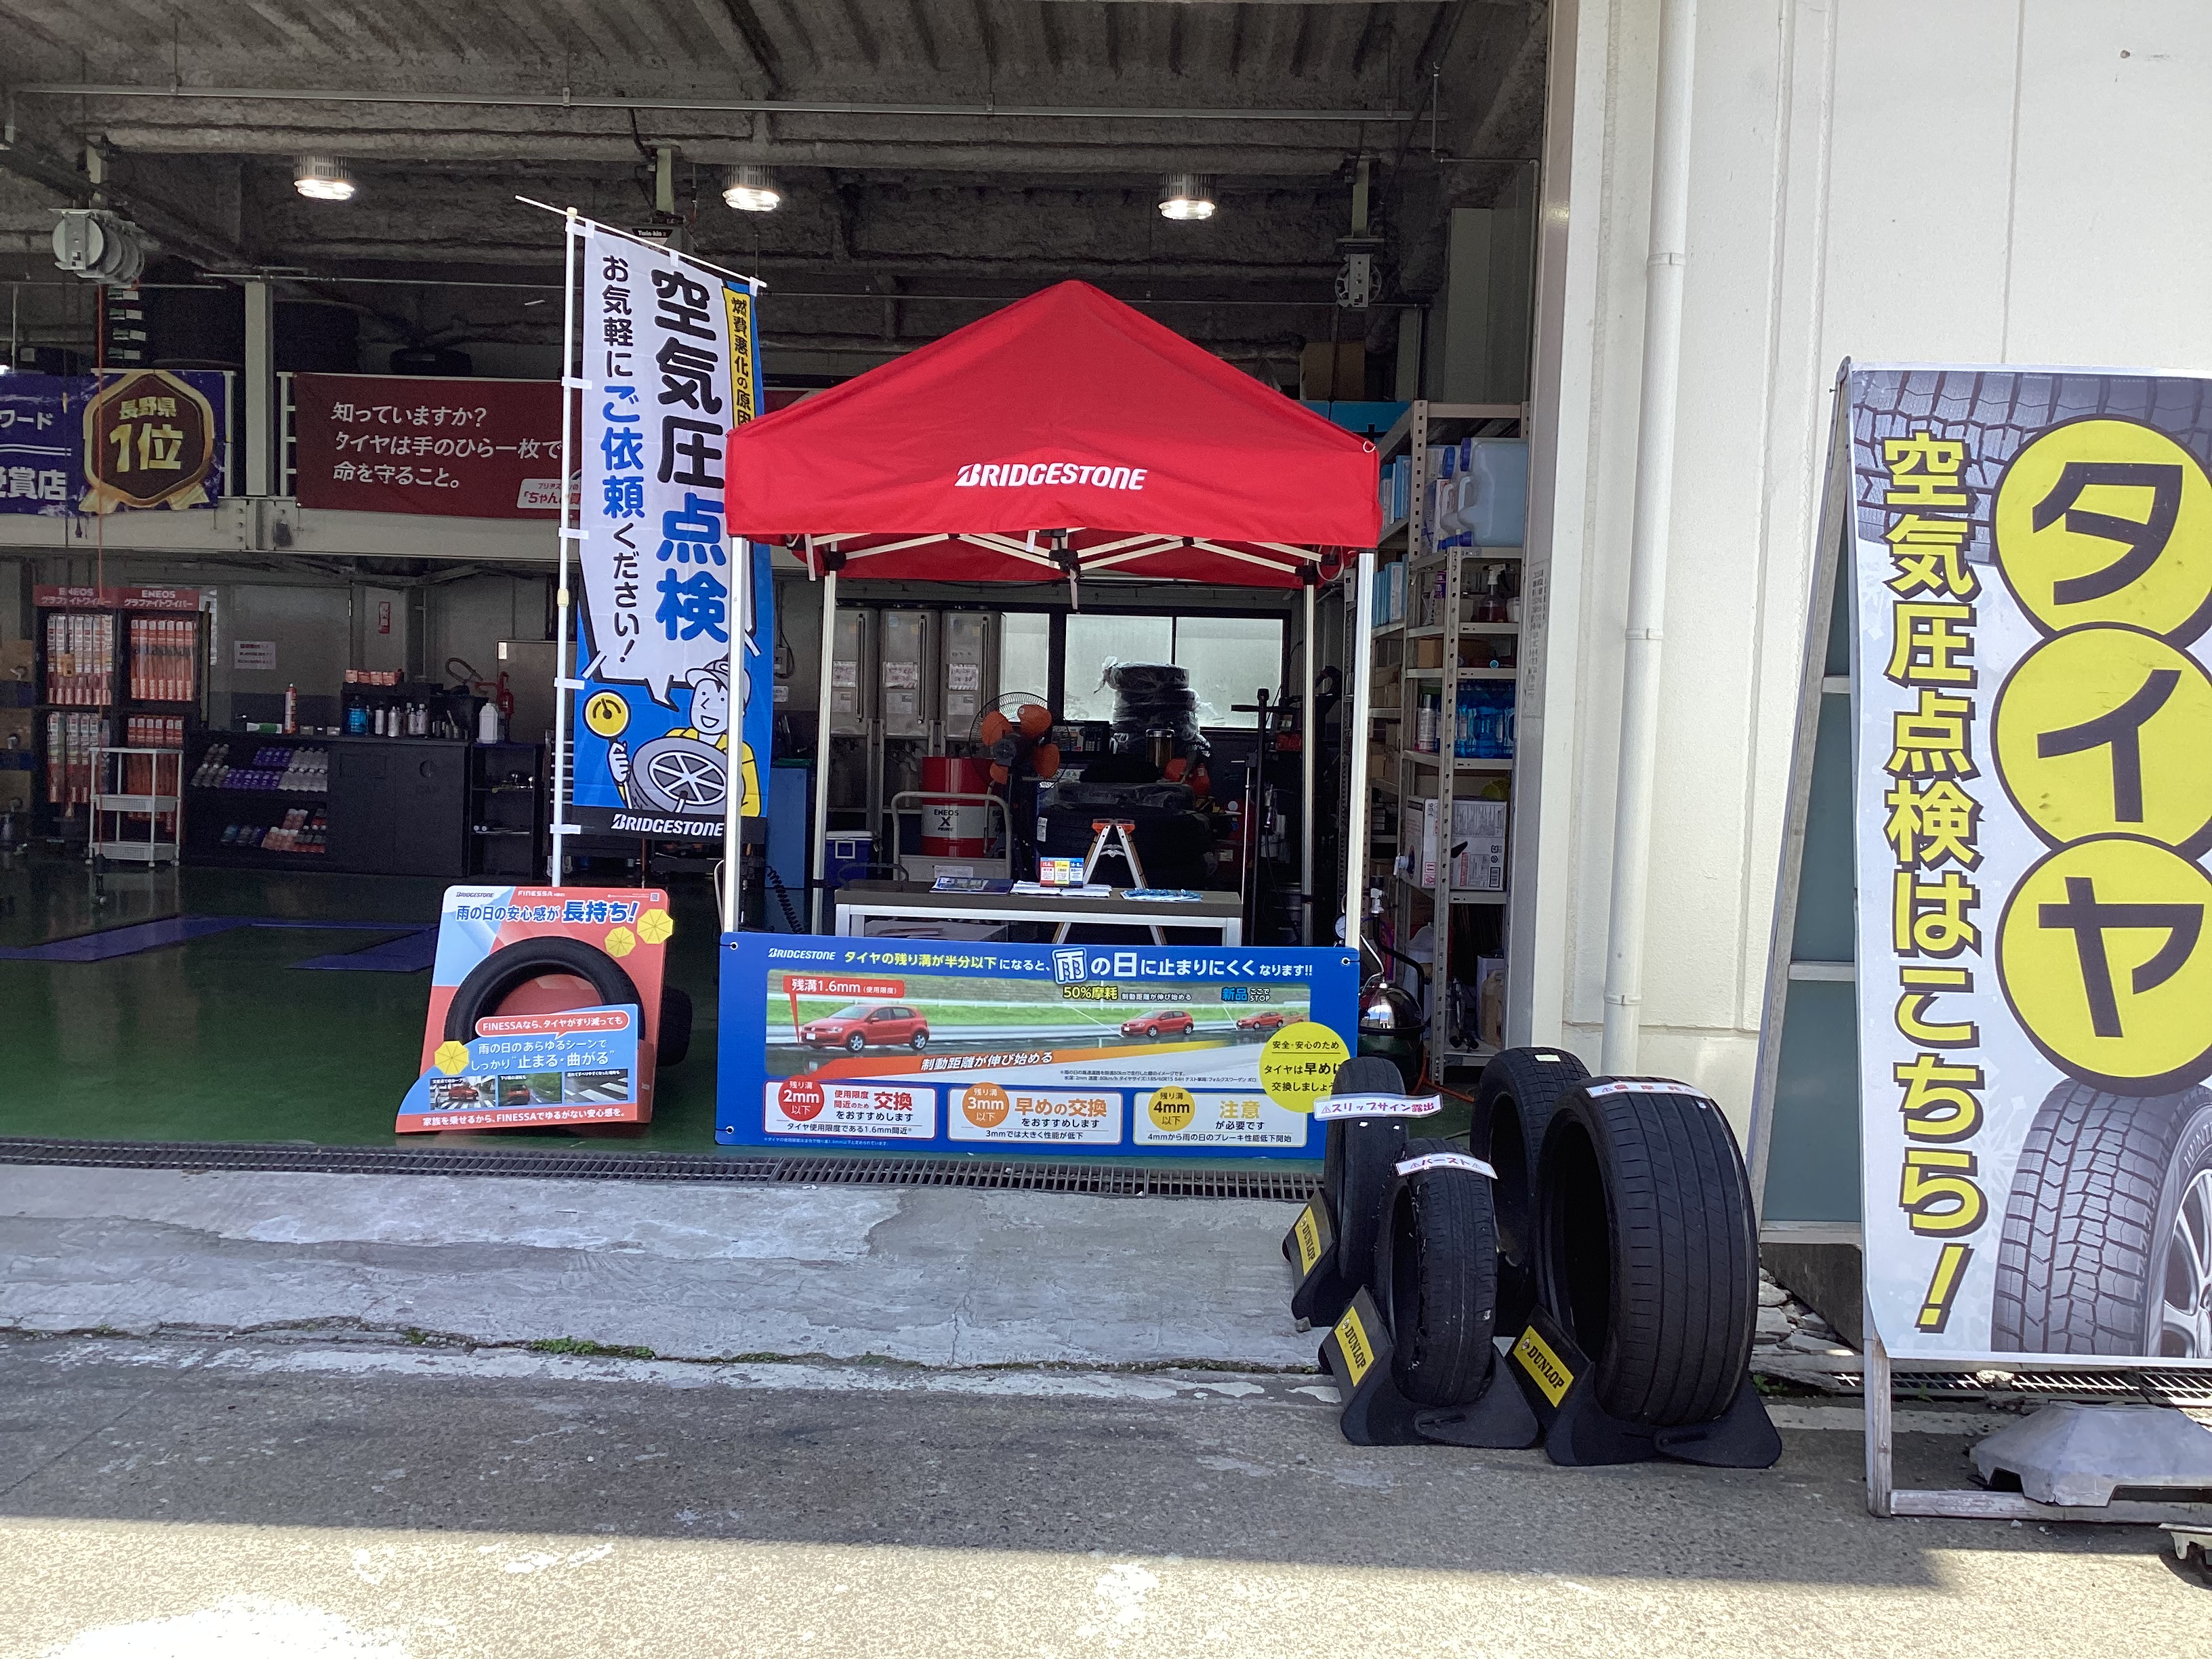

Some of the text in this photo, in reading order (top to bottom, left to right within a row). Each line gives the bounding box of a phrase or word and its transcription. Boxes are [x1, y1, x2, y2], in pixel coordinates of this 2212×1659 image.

[731, 297, 752, 425] 燃費悪化の原因
[119, 396, 176, 420] 長野県
[331, 401, 487, 428] 知っていますか?
[109, 423, 184, 472] 1位
[335, 431, 562, 459] タイヤは手のひら一枚で
[651, 269, 729, 643] 空気圧点検
[333, 461, 459, 489] 命を守ること。
[954, 463, 1148, 491] BRIDGESTONE
[58, 588, 94, 596] ENEOS
[142, 590, 176, 598] ENEOS
[2032, 461, 2205, 1038] タイヤ
[611, 814, 725, 836] BRIDGESTONE
[939, 817, 951, 827] X
[1883, 429, 1988, 1334] 空気圧点検はこちら!
[768, 947, 836, 960] BRIDGESTONE
[792, 978, 861, 993] 残溝1.6mm
[1063, 986, 1118, 1001] 50%摩耗
[1222, 987, 1248, 1002] 新品
[483, 1016, 623, 1031] FINESSAなら、タイヤがすり減っても
[478, 1039, 608, 1055] 雨の日のあらゆるシーンで
[1272, 1041, 1339, 1049] 安全・安心のため
[921, 1051, 1053, 1071] 制動距離が伸び始める
[783, 1089, 819, 1104] 2mm
[874, 1091, 913, 1111] 交換
[968, 1097, 1004, 1110] 3mm
[791, 1105, 811, 1115] 以下
[1015, 1097, 1107, 1118] 早めの交換
[1153, 1101, 1190, 1113] 4mm
[1219, 1100, 1261, 1120] 注意
[836, 1111, 914, 1122] をおすすめします
[976, 1112, 996, 1122] 以下
[1021, 1118, 1100, 1128] をおすすめします
[1161, 1115, 1181, 1126] 以下
[1215, 1120, 1265, 1130] が必要です
[985, 1129, 1084, 1140] 3mmでは大きく性能が低下
[1301, 1223, 1316, 1261] DUNLOP
[1344, 1326, 1366, 1370] DUNLOP
[1527, 1345, 1565, 1389] DUNLOP
